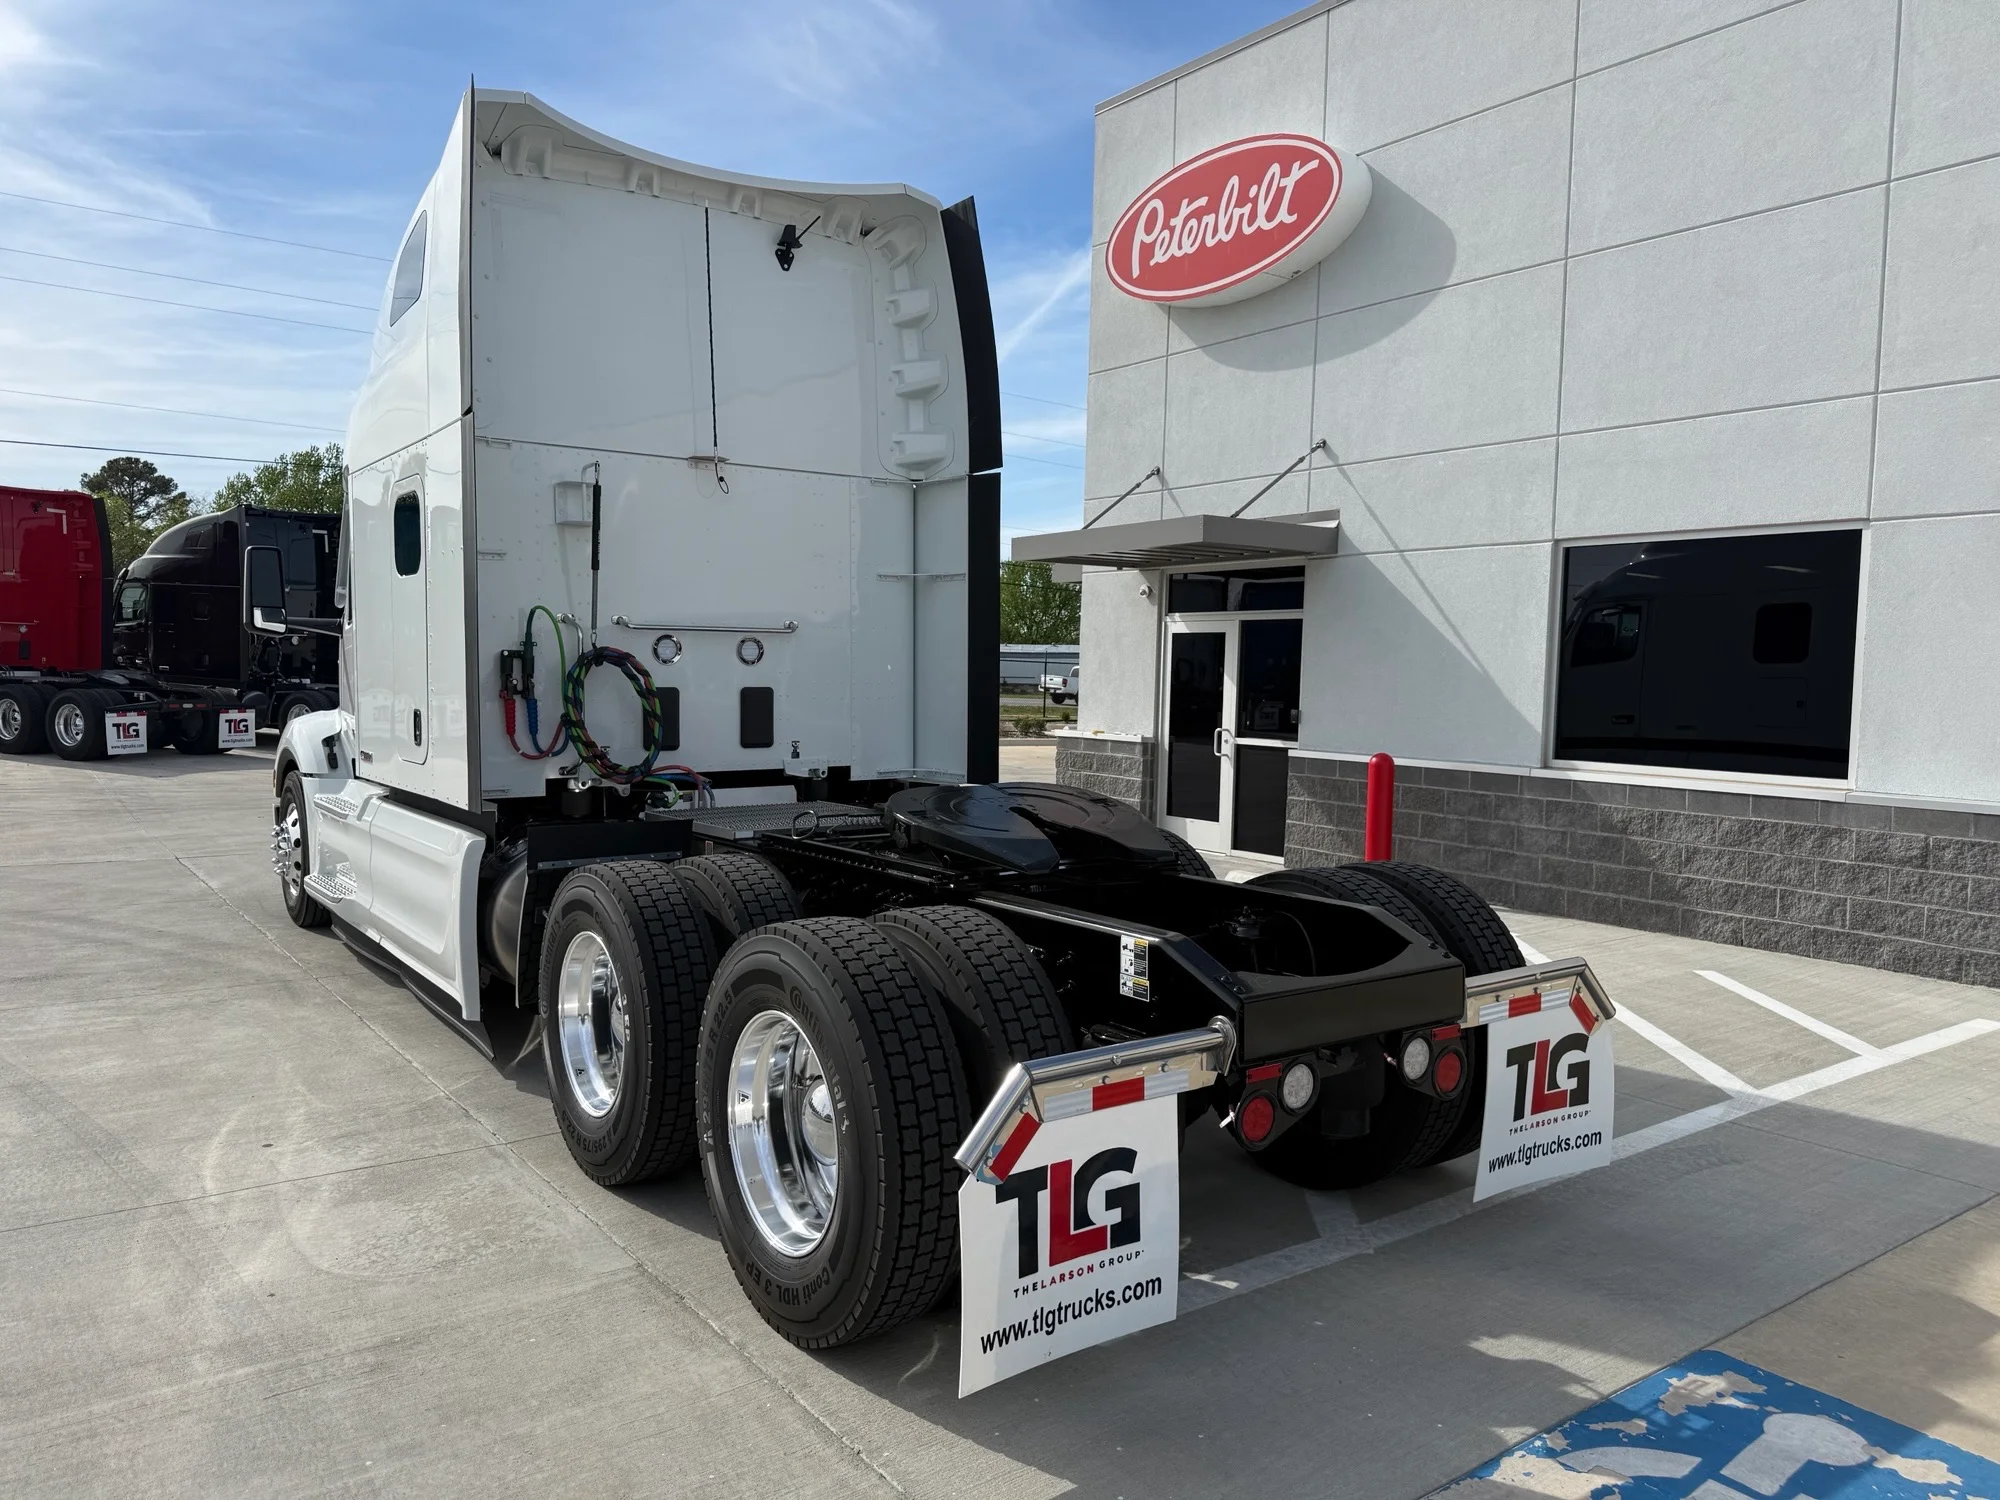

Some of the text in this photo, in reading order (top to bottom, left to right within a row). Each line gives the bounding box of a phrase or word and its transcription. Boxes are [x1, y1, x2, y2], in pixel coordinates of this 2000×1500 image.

[1131, 158, 1320, 279] Peterbilt
[112, 722, 140, 739] TLG
[225, 718, 249, 734] TLG
[713, 987, 734, 1024] 22.5
[708, 1027, 719, 1044] R
[1506, 1032, 1590, 1122] TLG
[1561, 1110, 1590, 1123] GROUP
[1488, 1130, 1602, 1173] www.tlgtrucks.com
[995, 1147, 1141, 1279] TLG
[1099, 1250, 1141, 1269] GROUP
[745, 1262, 830, 1306] Conti HDL 3 EP
[980, 1276, 1162, 1354] www.tlgtrucks.com
